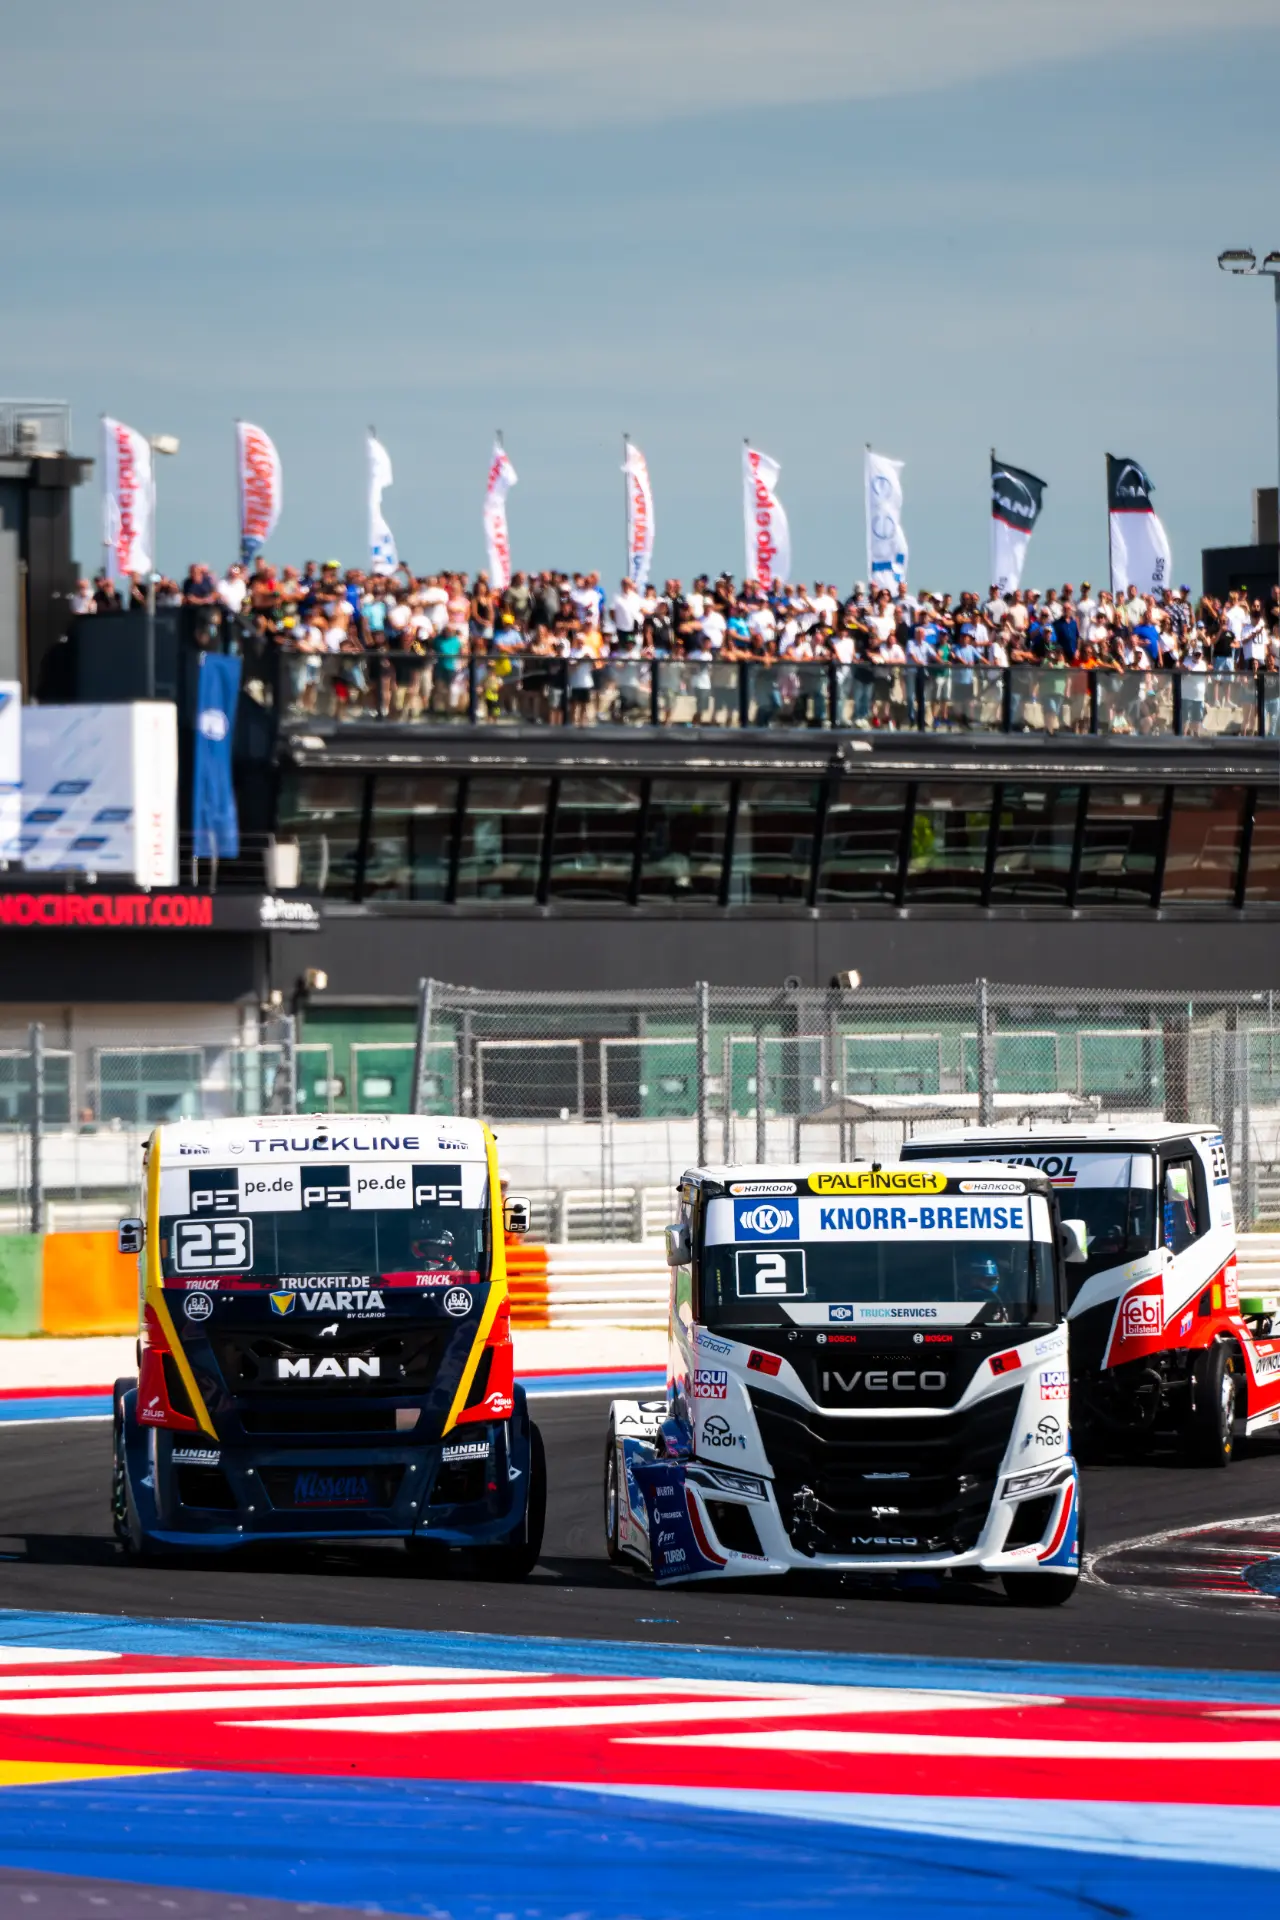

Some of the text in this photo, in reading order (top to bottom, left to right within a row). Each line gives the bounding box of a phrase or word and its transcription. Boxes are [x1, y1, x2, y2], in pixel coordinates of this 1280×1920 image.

[249, 1137, 420, 1152] TRUCKLINE
[245, 1178, 293, 1196] pe.de
[357, 1175, 406, 1193] pe.de
[818, 1173, 937, 1189] PALFINGER
[192, 1190, 239, 1211] PE
[304, 1186, 350, 1208] PE
[415, 1185, 462, 1206] PE
[820, 1207, 1024, 1230] KNORR-BREMSE
[181, 1223, 246, 1267] 23
[755, 1253, 787, 1293] 2
[279, 1276, 370, 1289] TRUCKFIT.DE
[300, 1290, 386, 1311] VARTA
[860, 1308, 937, 1318] TRUCKSERVICES
[1122, 1297, 1160, 1323] febi
[1128, 1325, 1158, 1334] bilstein
[828, 1335, 857, 1343] BOSCH
[924, 1335, 953, 1343] BOSCH
[277, 1357, 381, 1378] MAN
[822, 1371, 947, 1392] IVECO
[702, 1432, 736, 1447] hadi
[172, 1449, 216, 1459] LUNAU
[442, 1443, 486, 1455] LUNAU
[851, 1537, 918, 1545] IVECO
[664, 1548, 686, 1563] TURBO
